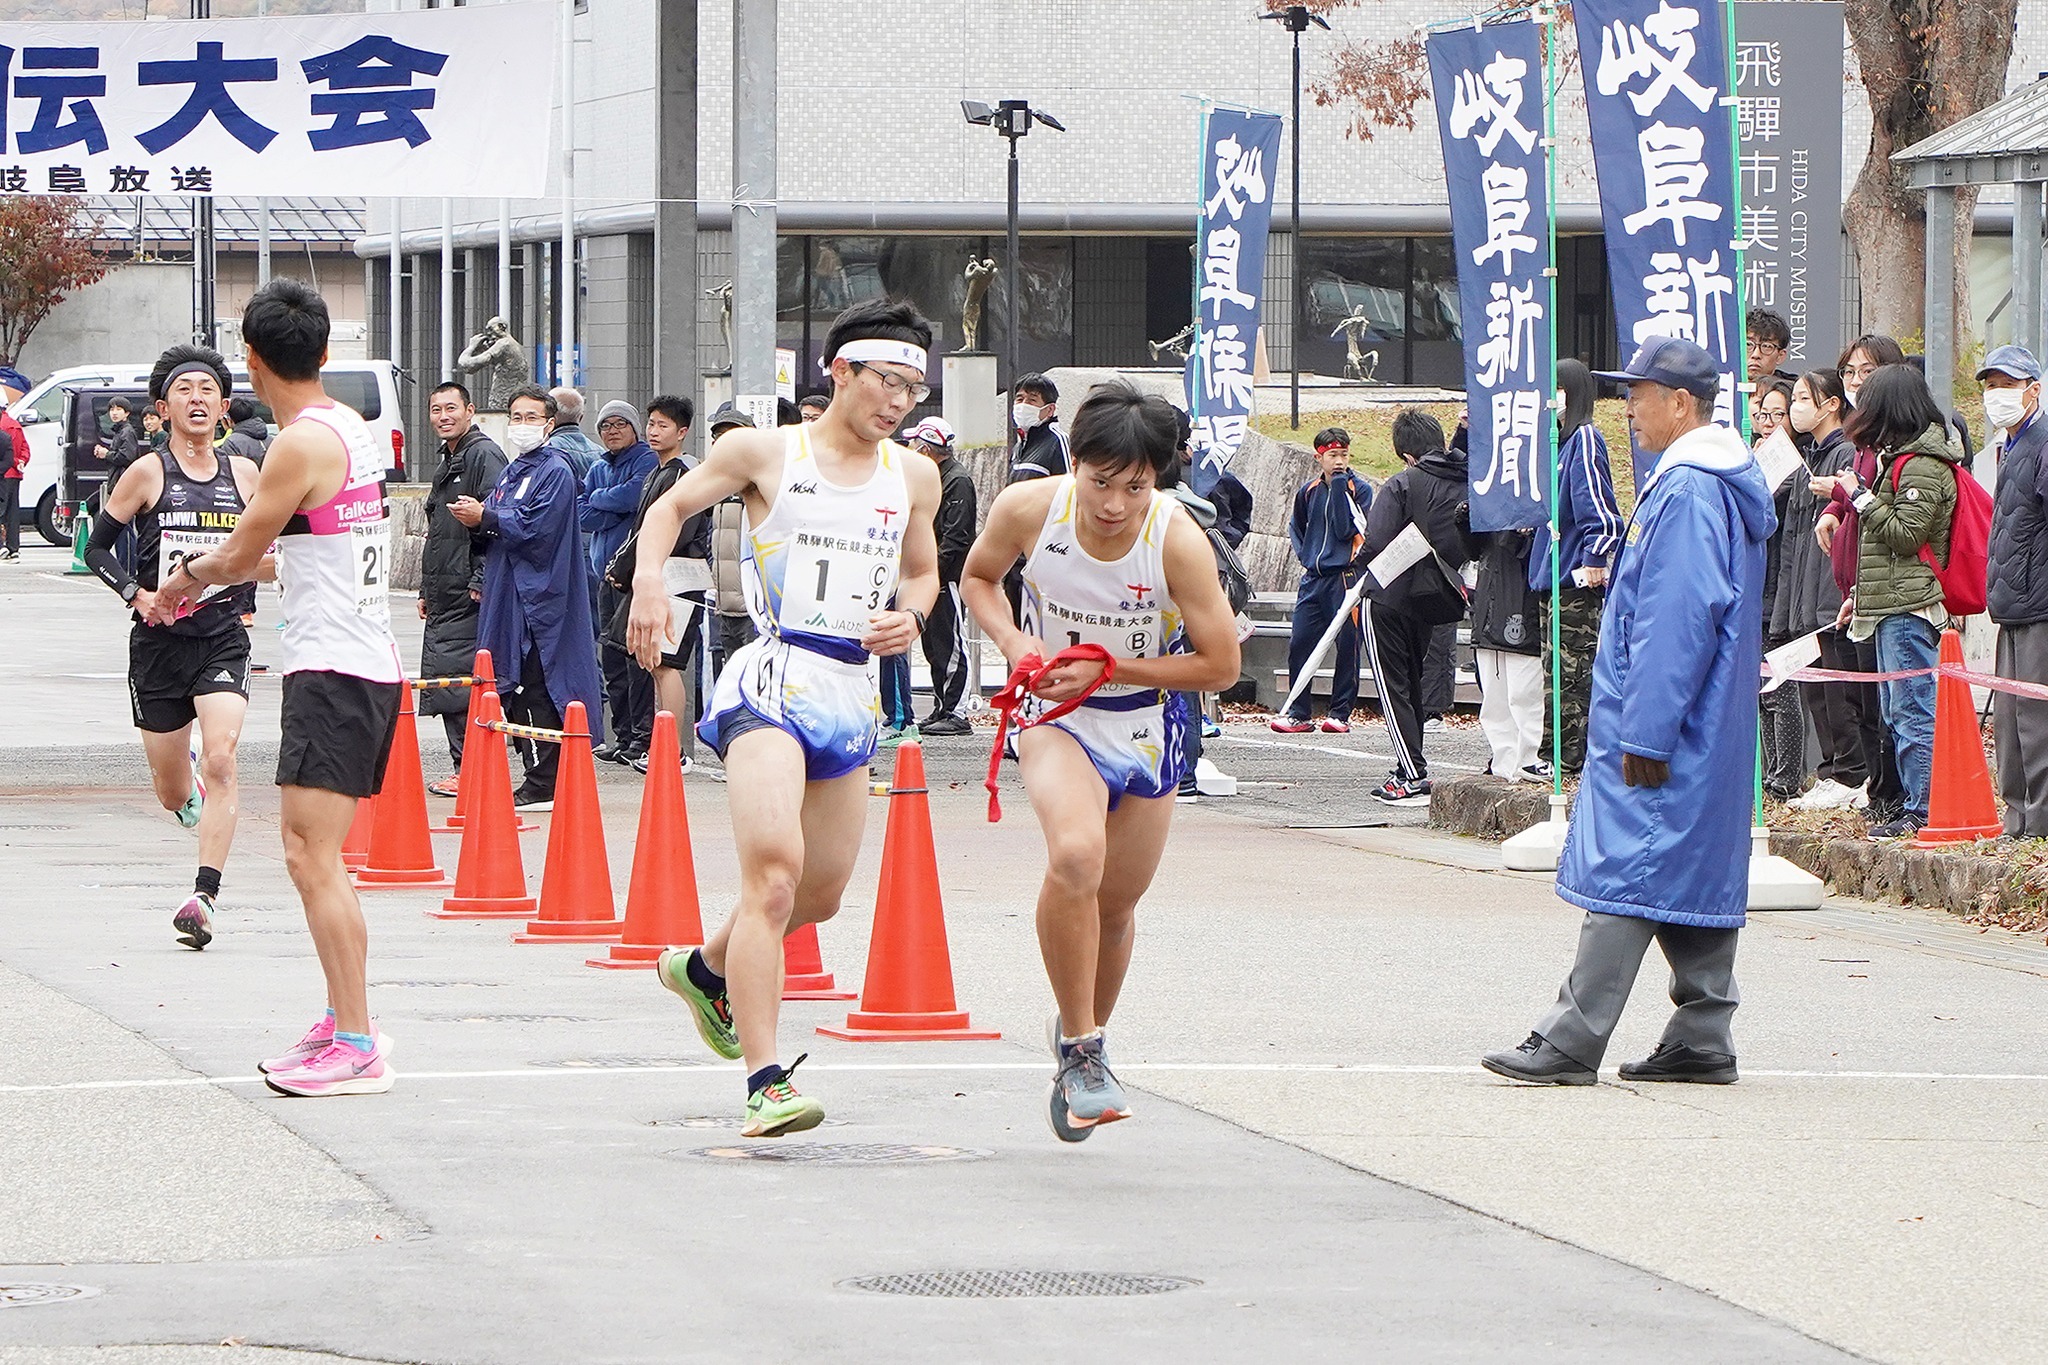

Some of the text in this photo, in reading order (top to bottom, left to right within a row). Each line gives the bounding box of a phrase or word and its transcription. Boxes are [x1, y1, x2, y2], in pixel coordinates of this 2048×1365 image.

[0, 35, 450, 157] 伝大会
[0, 164, 213, 193] 岐阜放送
[1788, 149, 1810, 362] HIDA CITY MUSEUM
[1449, 50, 1544, 503] 岐阜新聞
[158, 511, 198, 527] SANWA
[796, 532, 896, 559] 飛騨駅伝競走大会
[815, 559, 830, 602] 1
[1047, 601, 1154, 629] 飛騨駅伝競走大会
